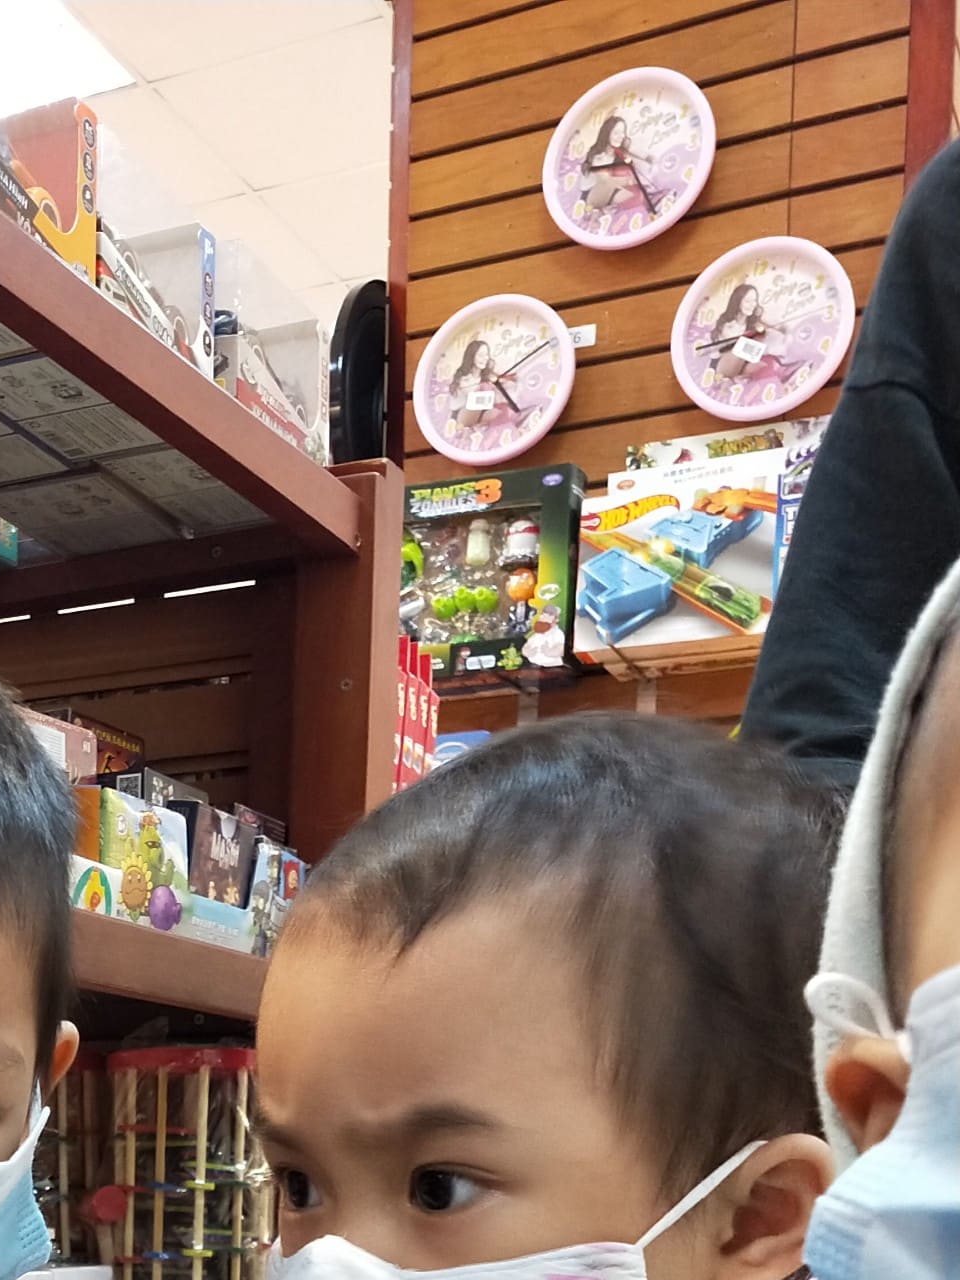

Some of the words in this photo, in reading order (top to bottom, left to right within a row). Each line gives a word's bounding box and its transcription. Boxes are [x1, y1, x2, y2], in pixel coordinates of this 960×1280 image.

[474, 478, 503, 504] 3
[600, 507, 628, 531] HOT
[627, 494, 680, 522] WHEELS
